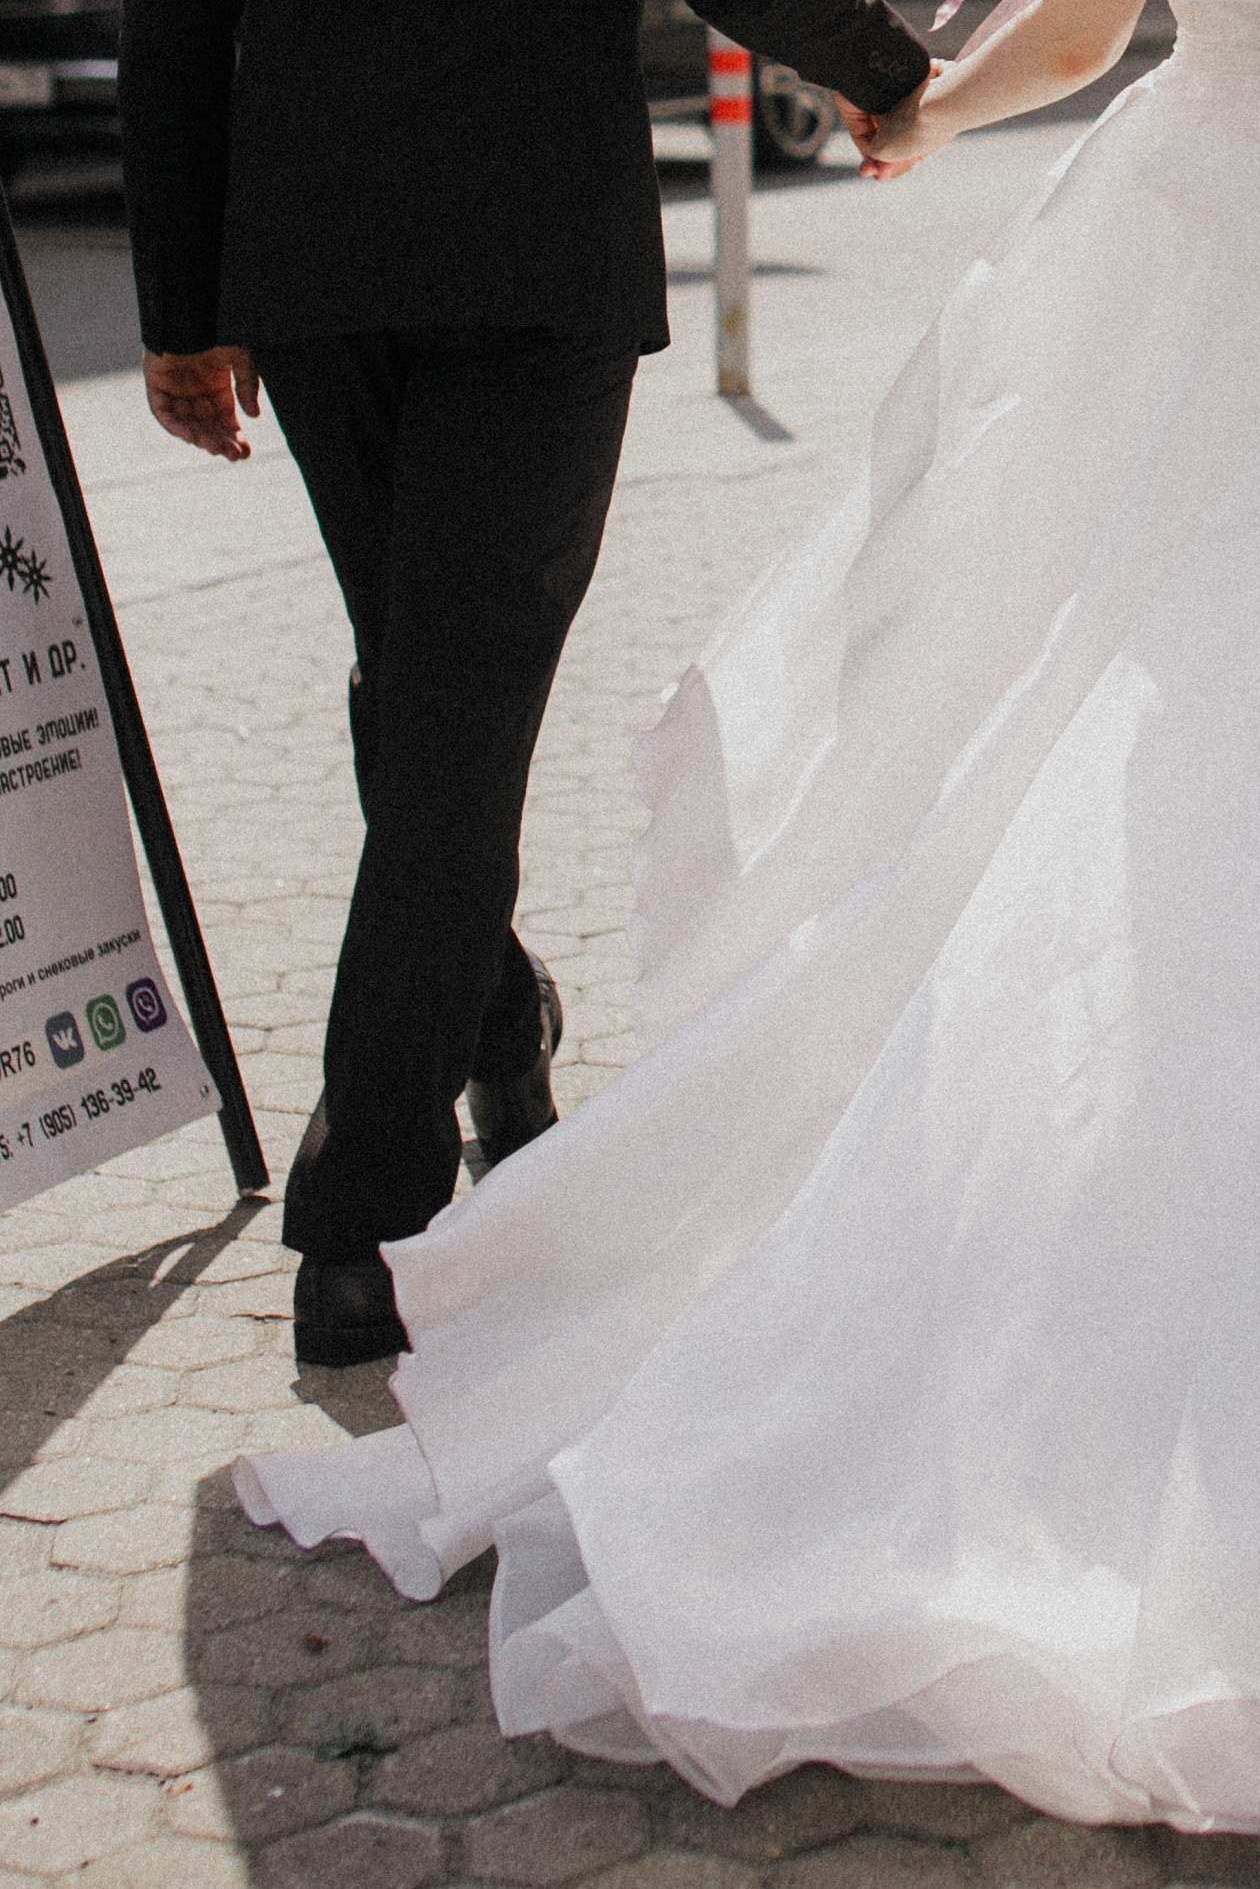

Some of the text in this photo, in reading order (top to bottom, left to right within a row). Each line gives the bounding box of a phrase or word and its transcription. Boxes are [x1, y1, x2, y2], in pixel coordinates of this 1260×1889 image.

[22, 650, 42, 685] И
[0, 706, 100, 760] ВЫЕ ЭМОЦИИ!
[0, 914, 26, 948] .00
[27, 971, 37, 987] и
[0, 1040, 36, 1079] R76
[17, 1122, 34, 1148] +7
[39, 1102, 78, 1140] (905)
[80, 1067, 163, 1121] 136-39-42
